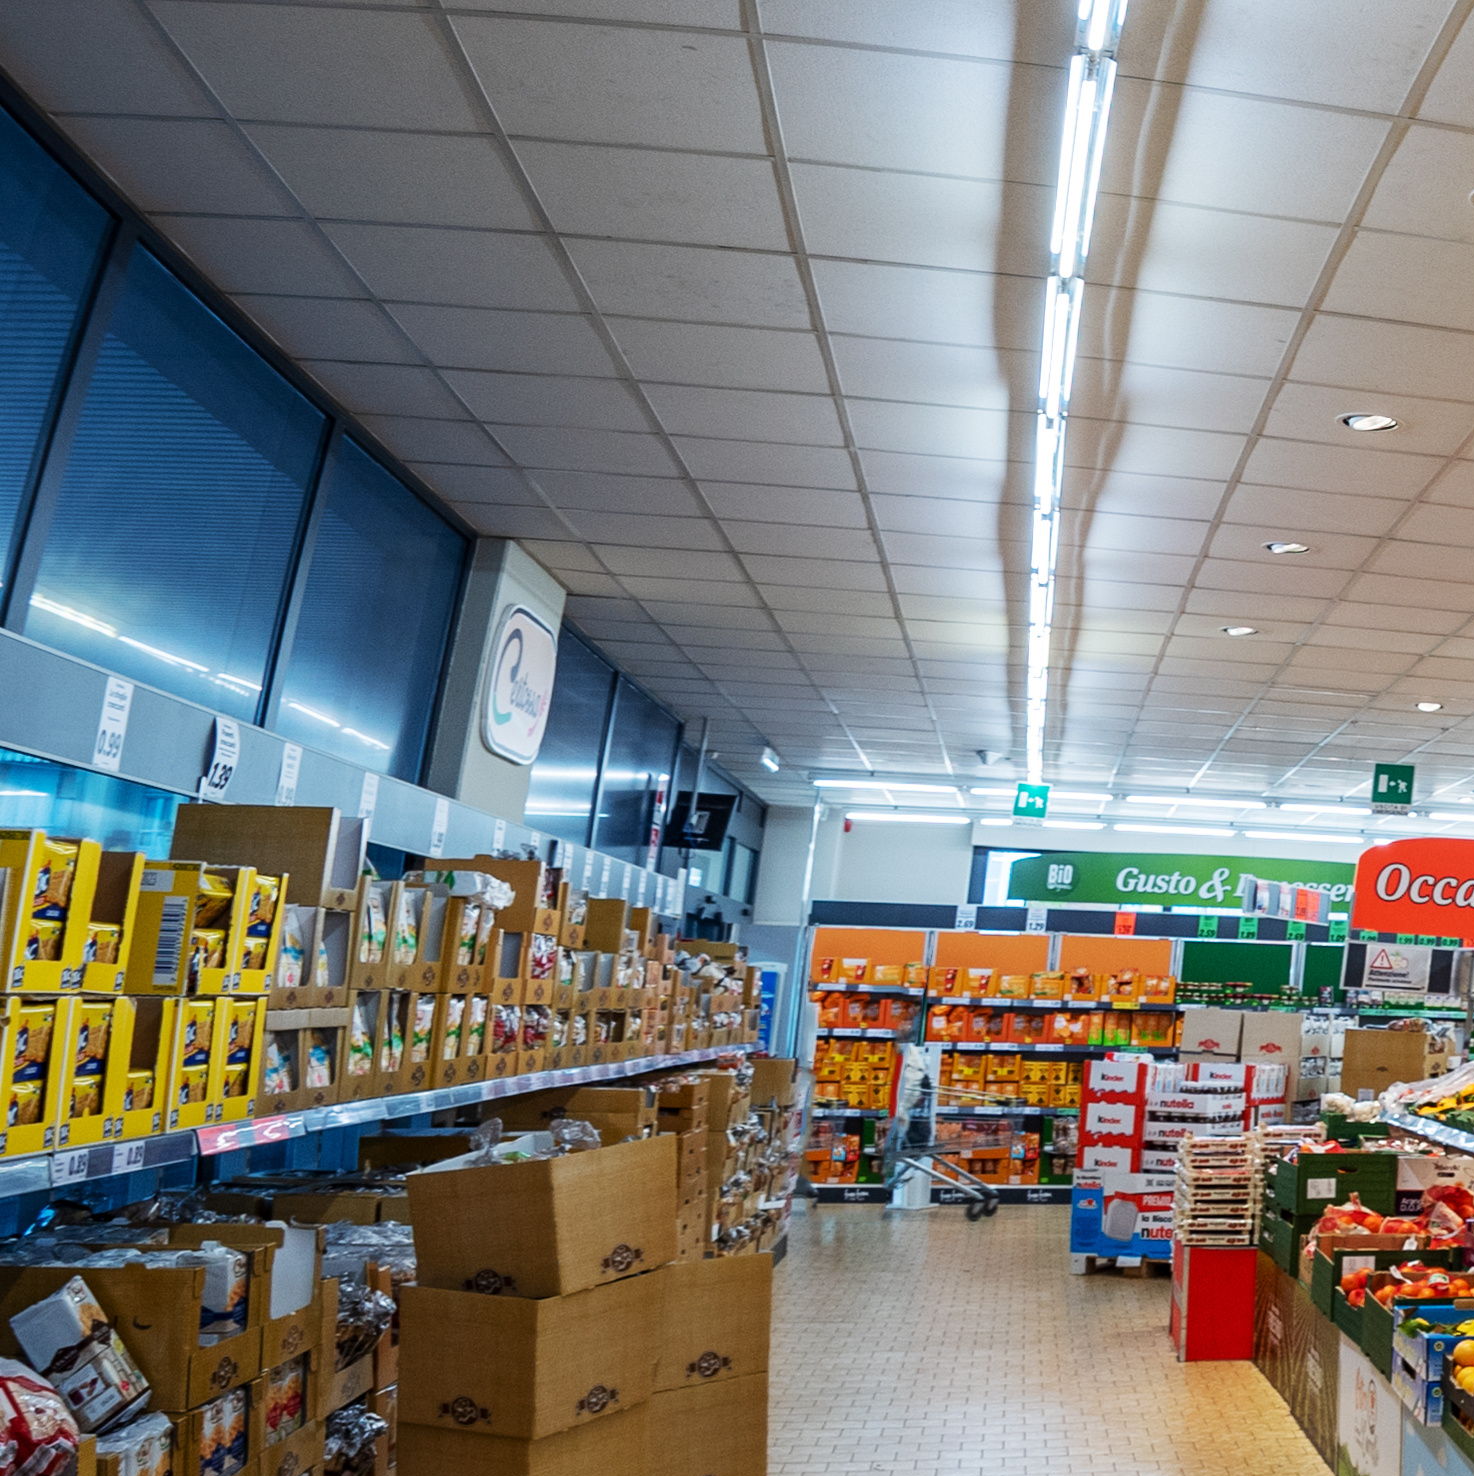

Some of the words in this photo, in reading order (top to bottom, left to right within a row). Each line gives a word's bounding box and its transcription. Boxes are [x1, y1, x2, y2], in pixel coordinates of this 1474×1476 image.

[208, 762, 233, 790] 1.39
[1116, 867, 1196, 895] Gusto
[1199, 868, 1232, 902] &
[1101, 1072, 1124, 1082] kinder
[1210, 1071, 1232, 1080] kinder
[1159, 1099, 1194, 1109] nutella
[1098, 1116, 1121, 1125] kinder
[1094, 1159, 1118, 1168] kinder
